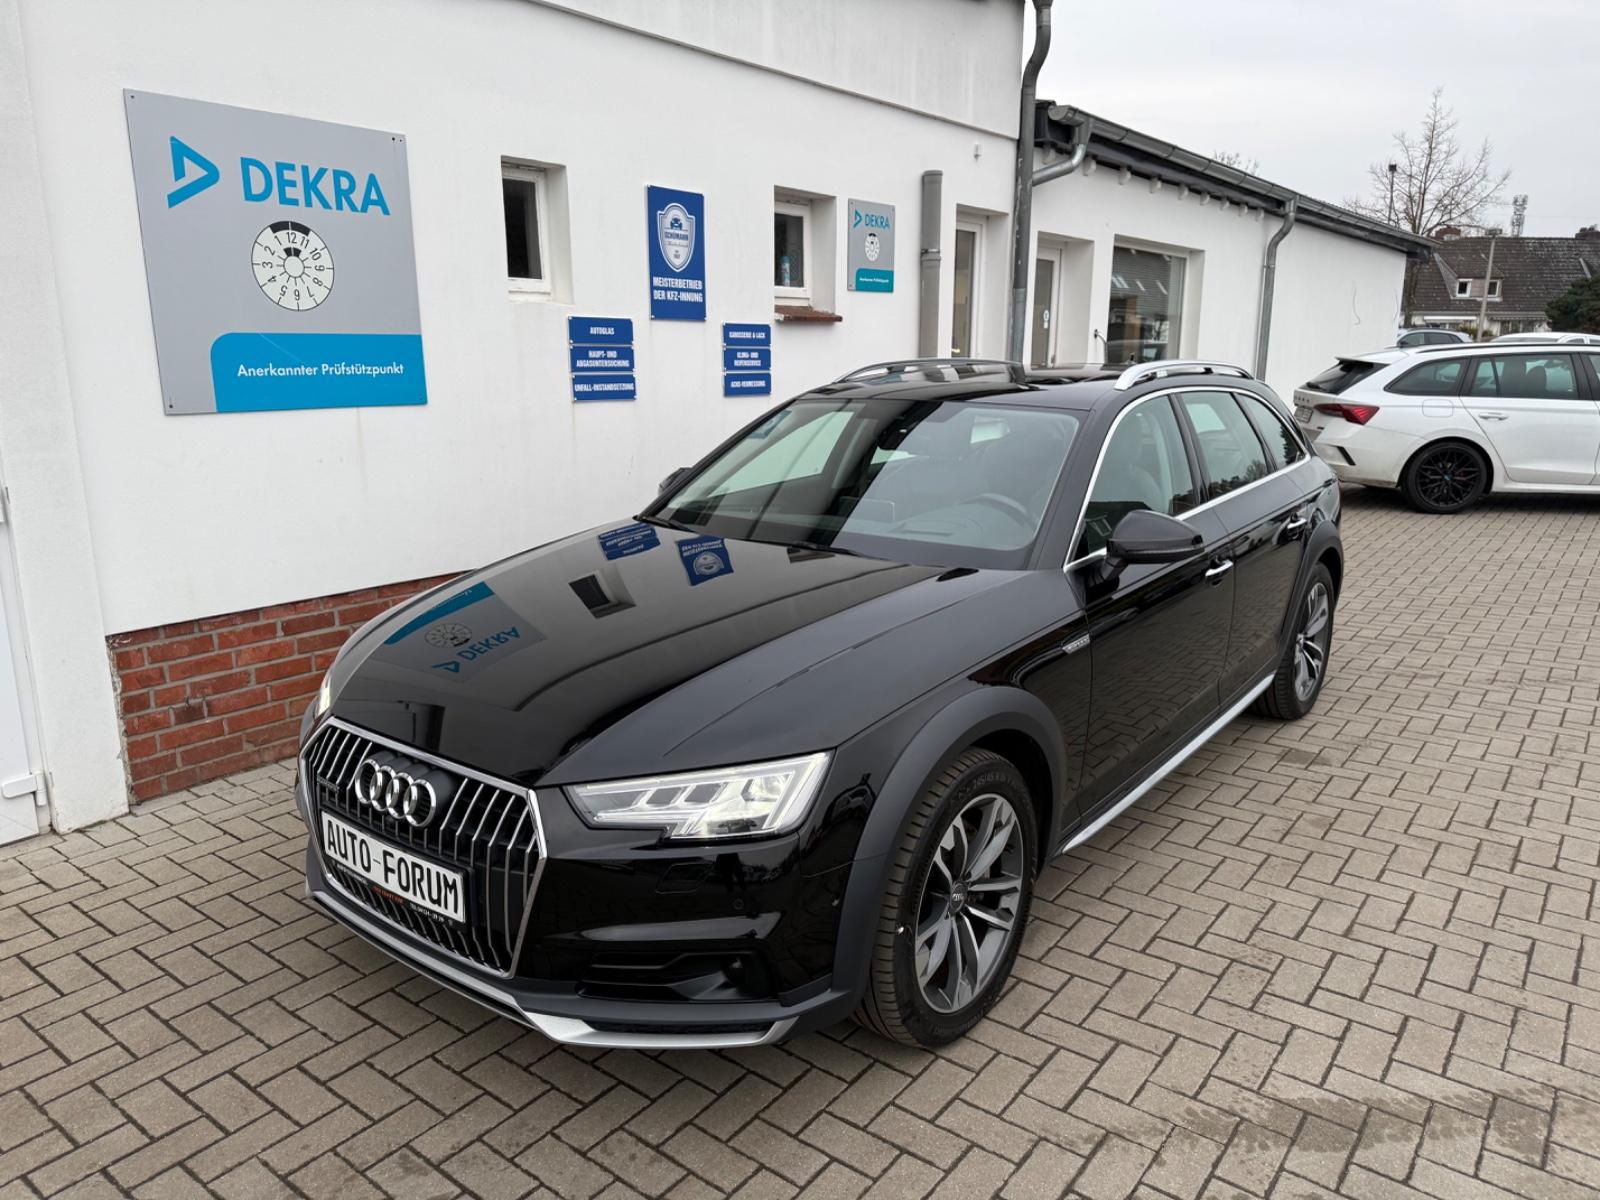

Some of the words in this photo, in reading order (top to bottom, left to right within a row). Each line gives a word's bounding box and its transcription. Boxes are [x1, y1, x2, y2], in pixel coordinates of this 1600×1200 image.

[239, 156, 391, 216] DEKRA
[864, 213, 891, 230] DEKRA
[274, 235, 282, 246] 1
[286, 231, 298, 244] 12
[300, 236, 310, 249] 11
[264, 245, 276, 256] 2
[309, 247, 322, 261] 10
[262, 261, 273, 269] 3
[314, 264, 325, 272] 9
[267, 275, 277, 283] 4
[312, 277, 324, 287] 8
[279, 285, 288, 297] 5
[294, 288, 300, 301] 6
[306, 285, 315, 298] 7
[653, 290, 667, 301] DER
[237, 363, 318, 378] Anerkannter
[321, 361, 404, 379] Prüfstützpunkt
[327, 819, 459, 915] AUTO-FORUM
